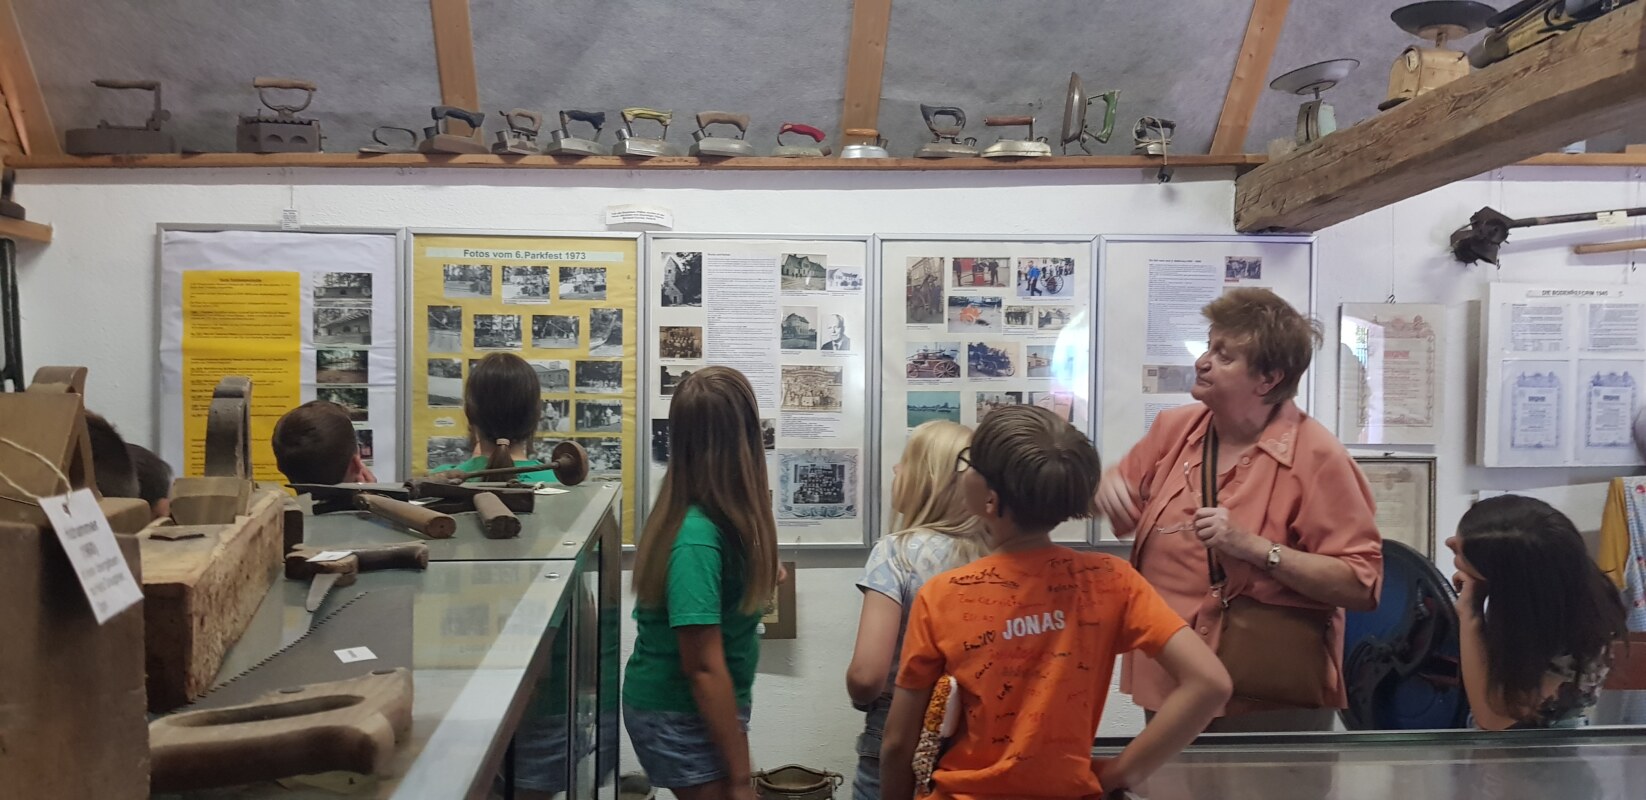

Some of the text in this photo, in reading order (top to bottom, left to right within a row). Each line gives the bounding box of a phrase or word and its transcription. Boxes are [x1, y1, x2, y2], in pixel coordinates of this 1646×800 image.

[463, 249, 490, 258] Fotos
[492, 251, 513, 259] vom
[565, 251, 587, 260] 1973
[1002, 609, 1066, 640] JONAS
